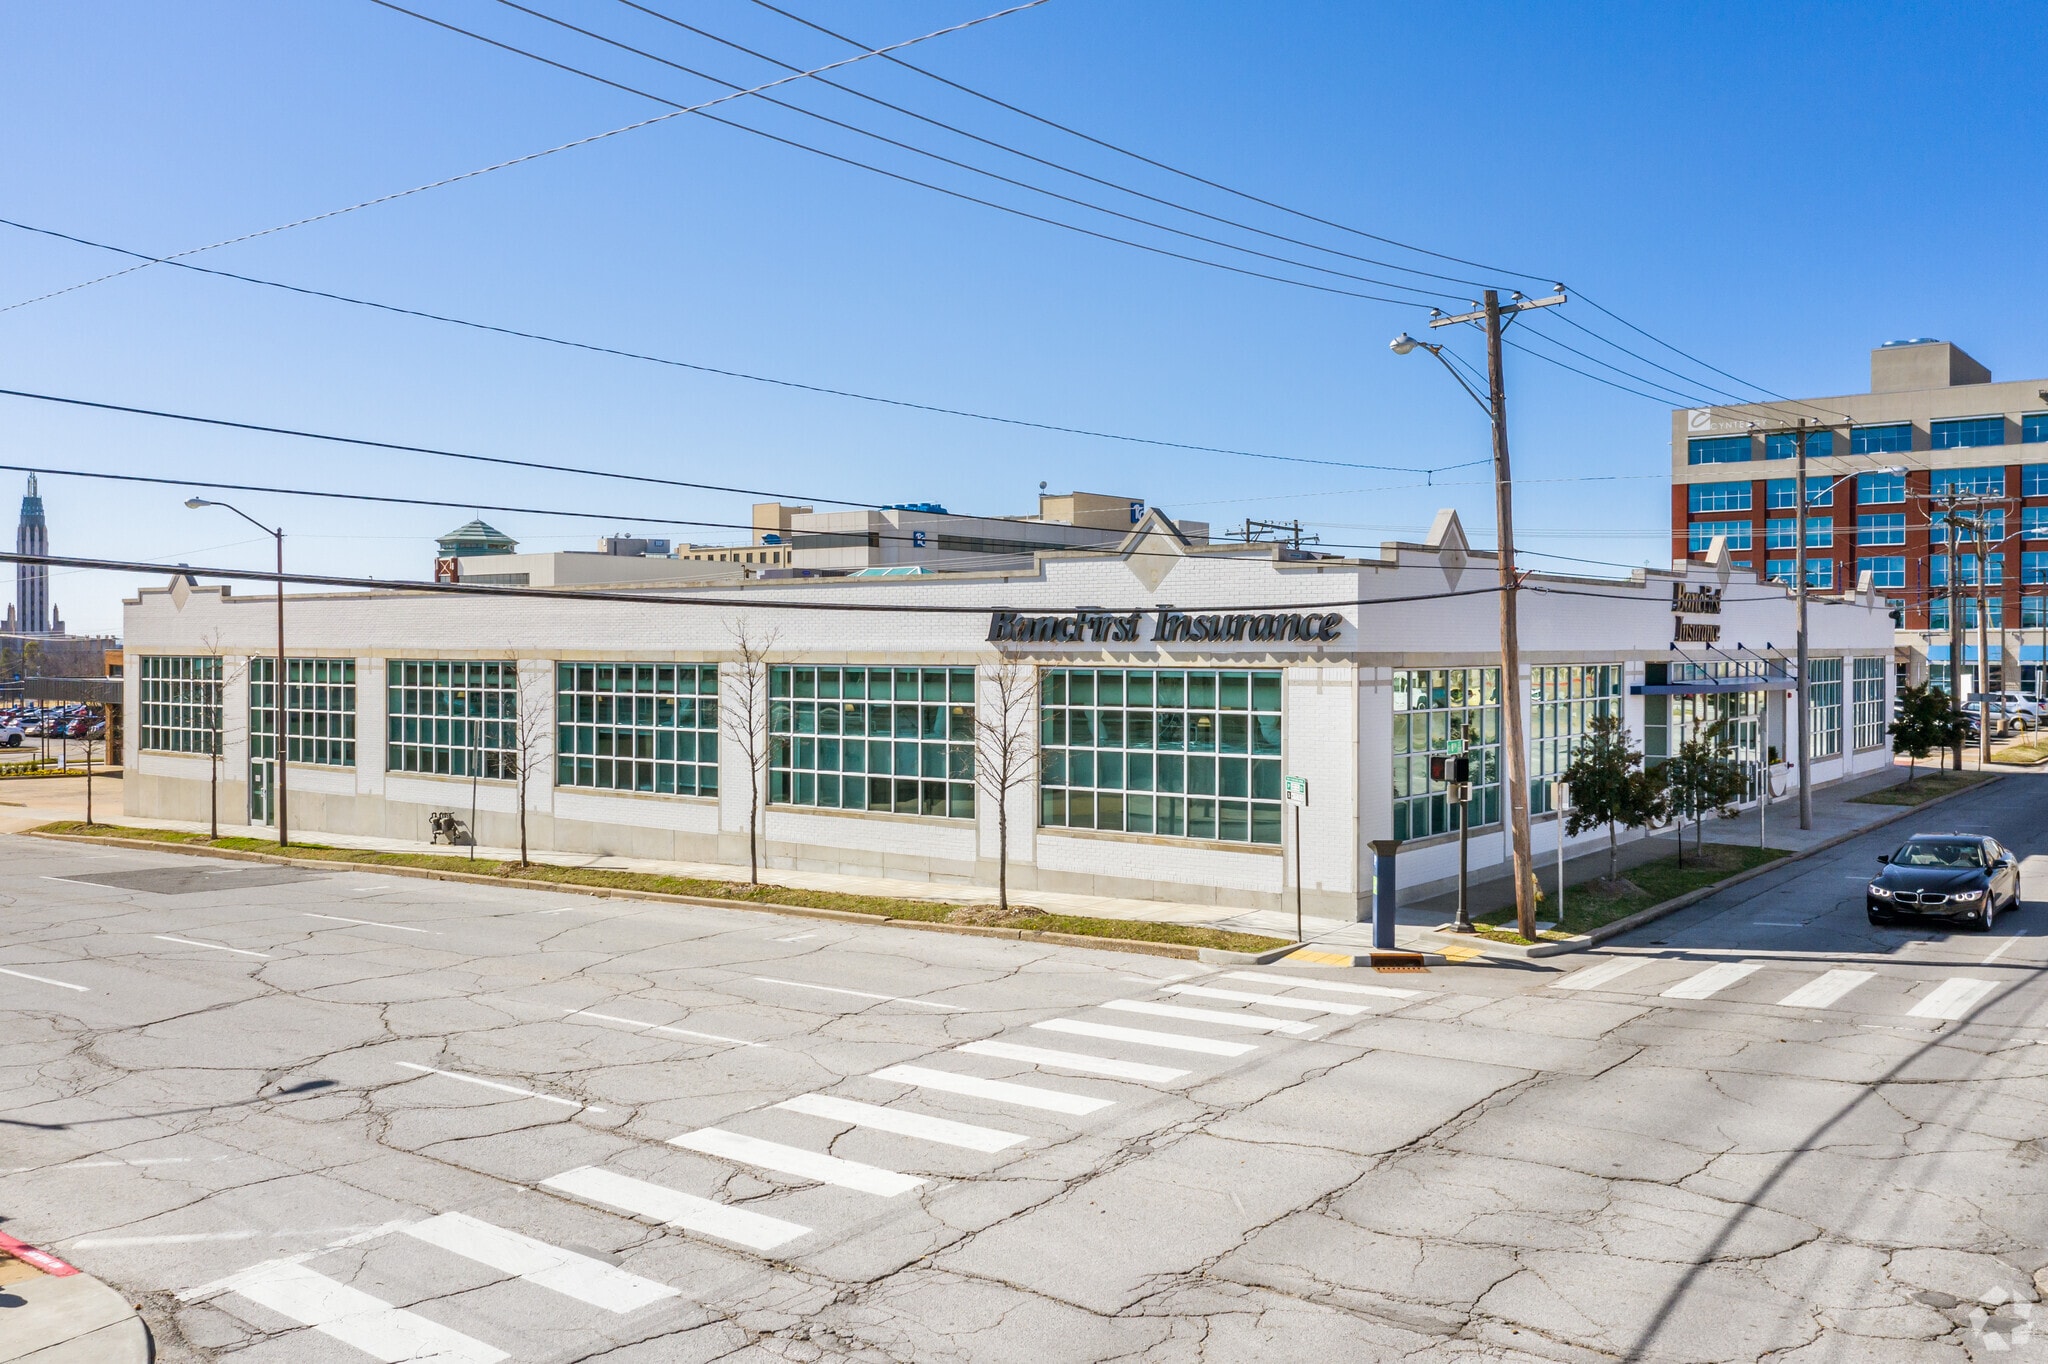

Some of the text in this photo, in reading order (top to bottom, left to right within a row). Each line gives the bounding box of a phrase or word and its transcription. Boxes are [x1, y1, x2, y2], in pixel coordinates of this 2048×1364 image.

[1711, 418, 1767, 430] CYNTEGY
[985, 604, 1344, 643] BancFirst Insurance
